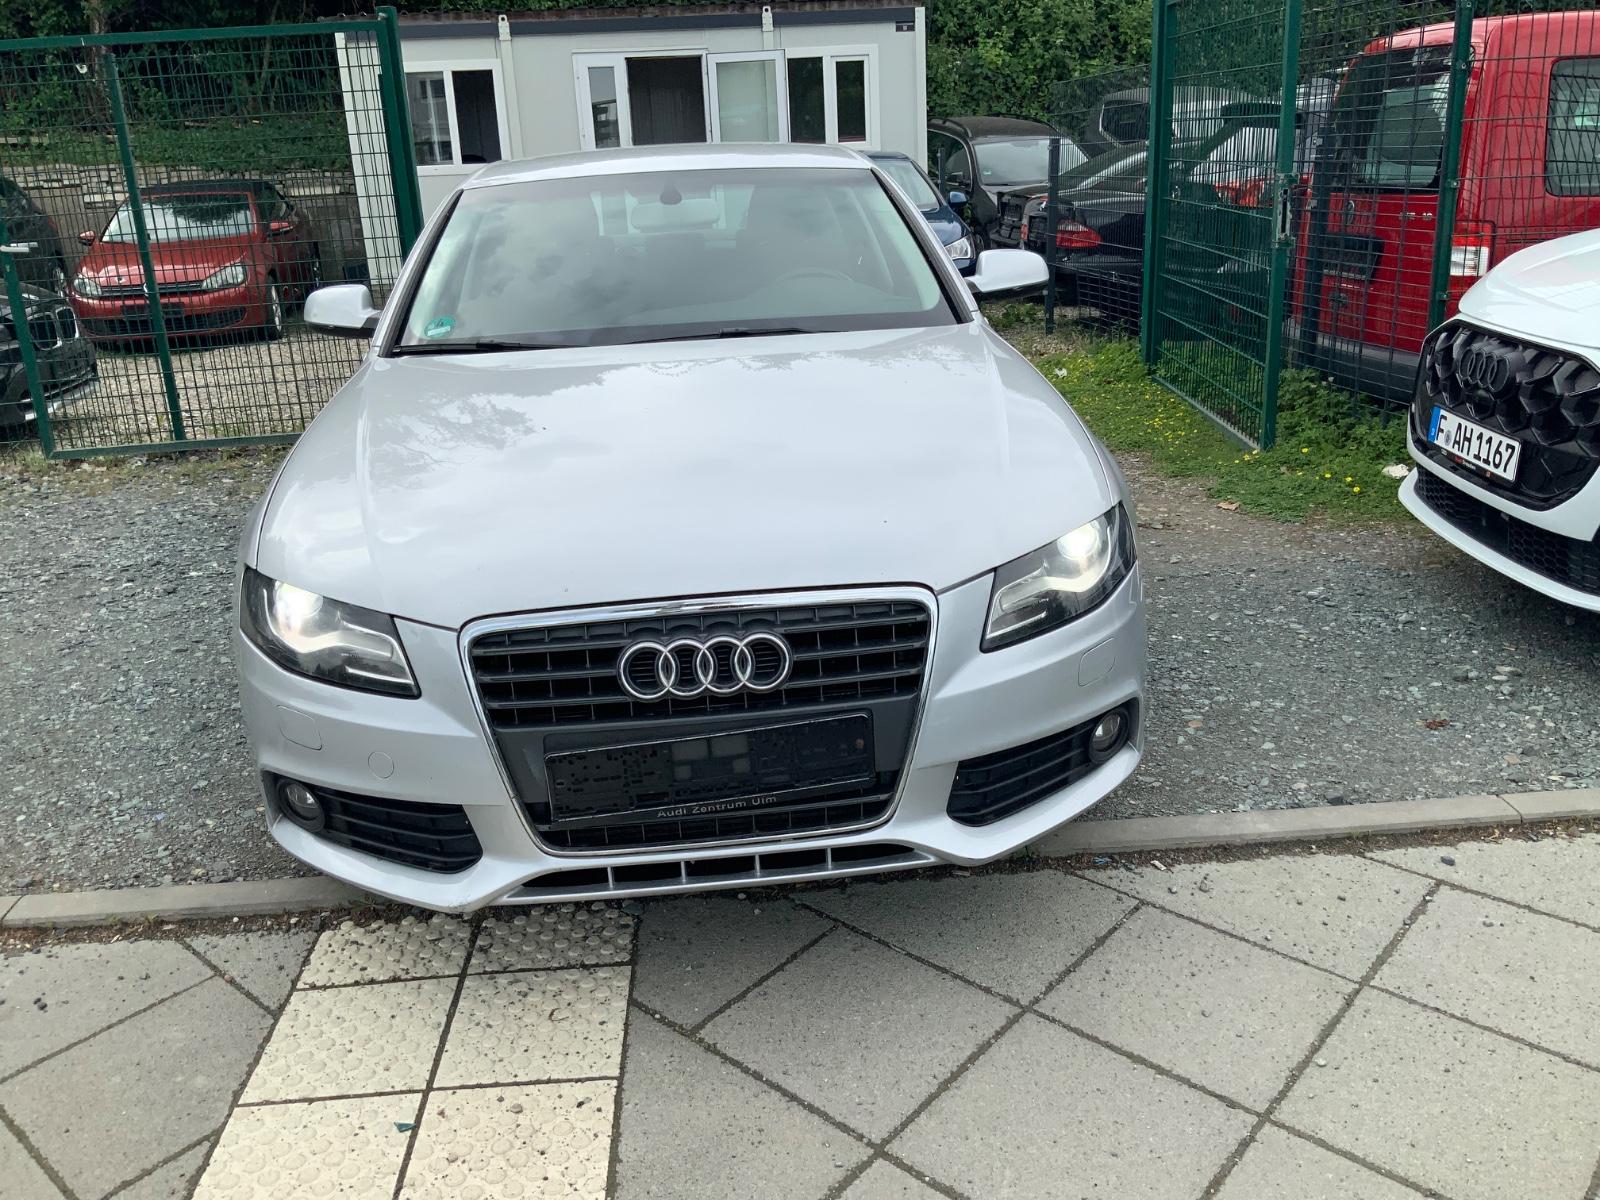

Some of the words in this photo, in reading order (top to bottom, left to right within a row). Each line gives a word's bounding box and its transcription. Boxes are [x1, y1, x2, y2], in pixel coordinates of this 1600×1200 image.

[1436, 414, 1448, 441] F
[1452, 422, 1474, 456] AH
[1473, 432, 1516, 473] 1167
[657, 806, 687, 818] Audi
[691, 801, 747, 814] Zentrum
[751, 795, 777, 806] Ulm
